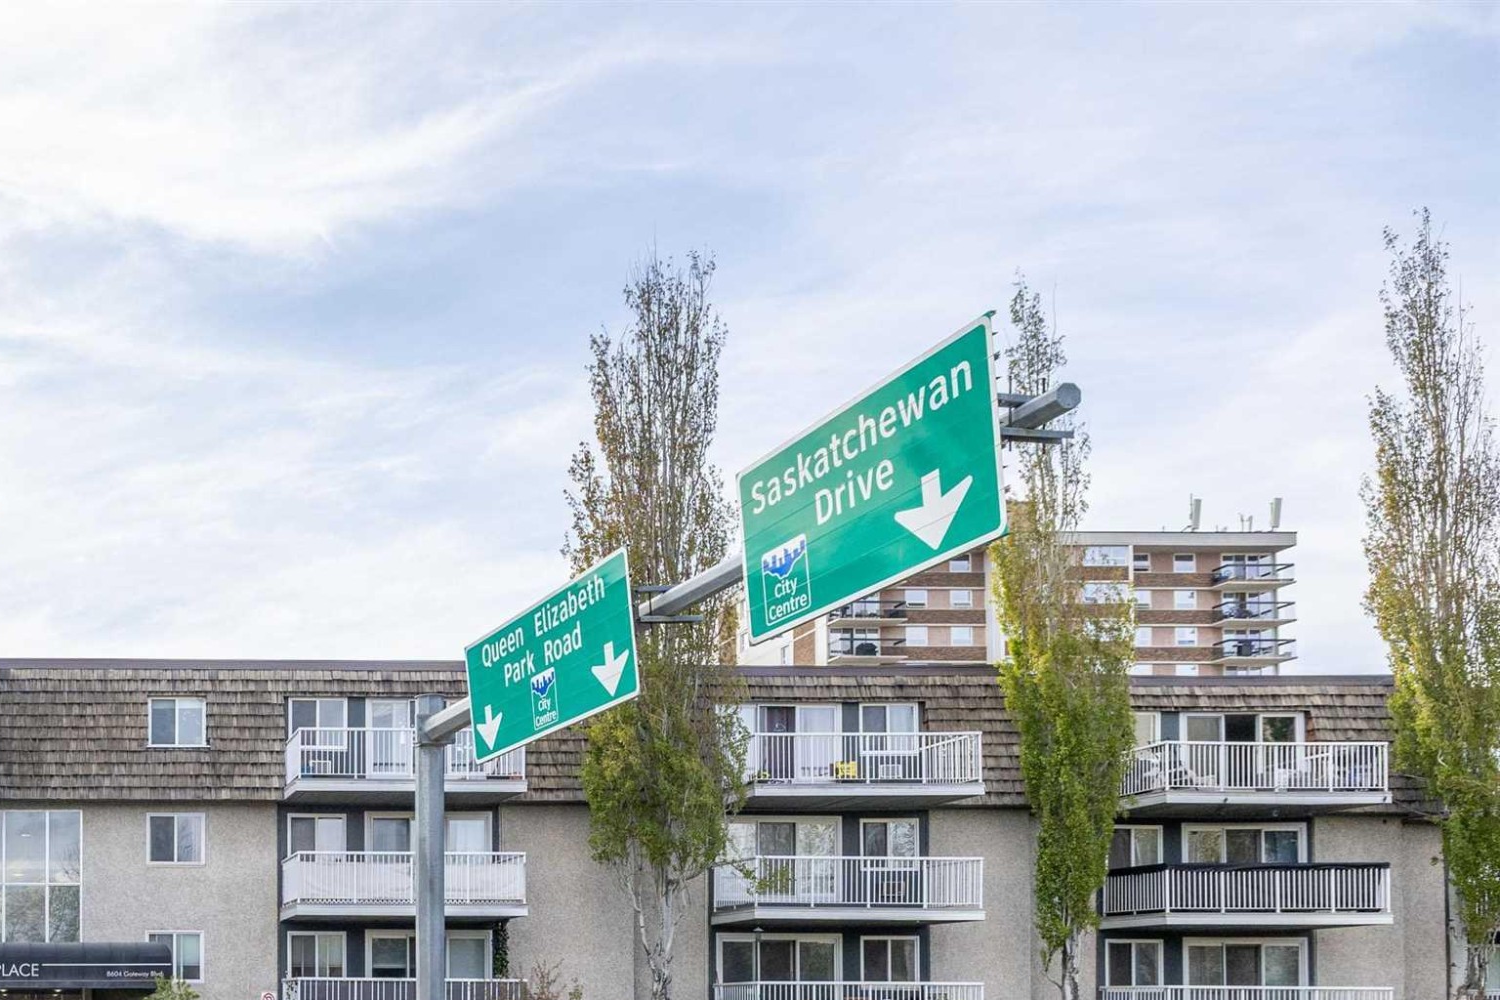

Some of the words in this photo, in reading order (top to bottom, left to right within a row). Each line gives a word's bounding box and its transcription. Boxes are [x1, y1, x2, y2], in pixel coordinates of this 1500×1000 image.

[751, 359, 973, 515] Saskatchewan
[814, 458, 894, 526] Drive
[481, 626, 525, 667] Queen
[534, 574, 605, 637] Elizabeth
[768, 593, 808, 620] Centre
[774, 577, 798, 599] City
[504, 650, 536, 687] Park
[544, 621, 583, 666] Road
[535, 710, 557, 727] Centre
